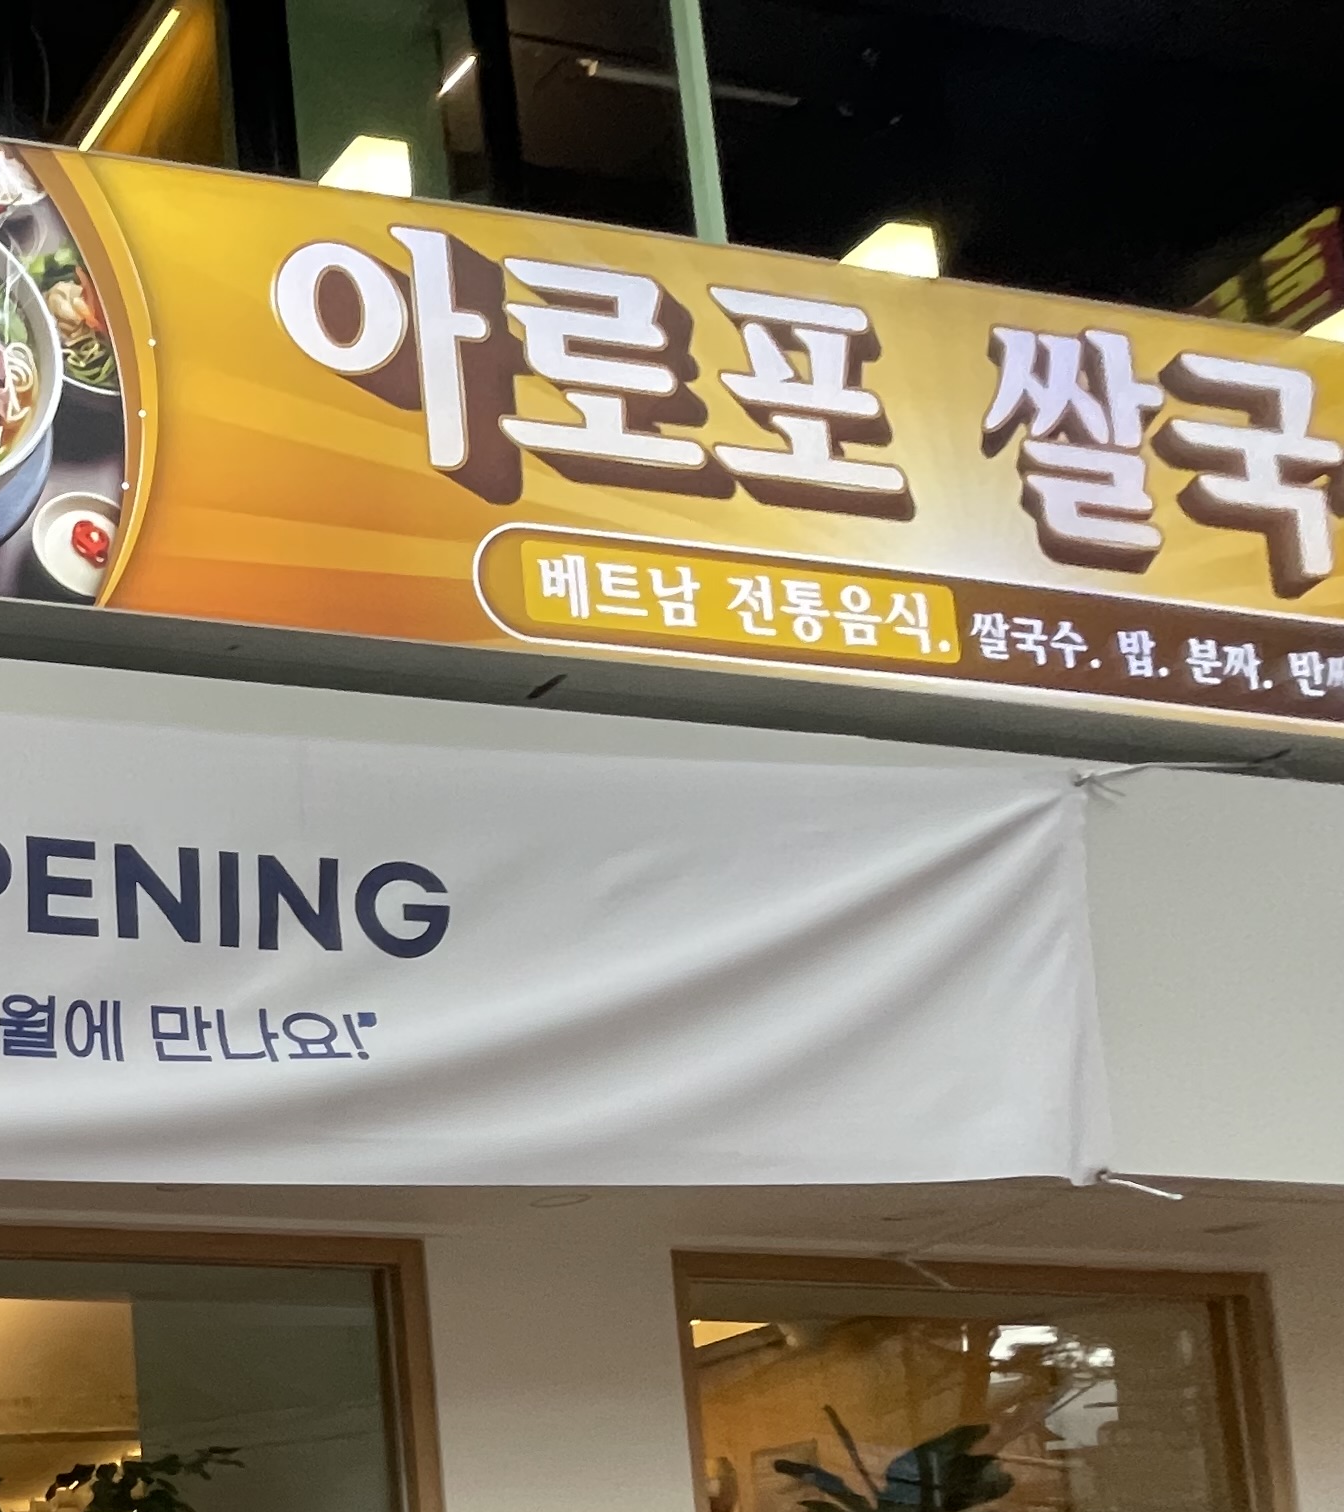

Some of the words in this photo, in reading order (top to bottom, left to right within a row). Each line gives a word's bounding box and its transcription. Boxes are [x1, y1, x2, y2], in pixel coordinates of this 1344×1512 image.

[272, 225, 909, 494] 아로포
[536, 553, 701, 627] 베트남
[726, 574, 952, 655] 전통음식.
[969, 612, 1102, 669] 쌀국수.
[1116, 630, 1170, 678] 밥.
[1185, 637, 1273, 691] 분짜.
